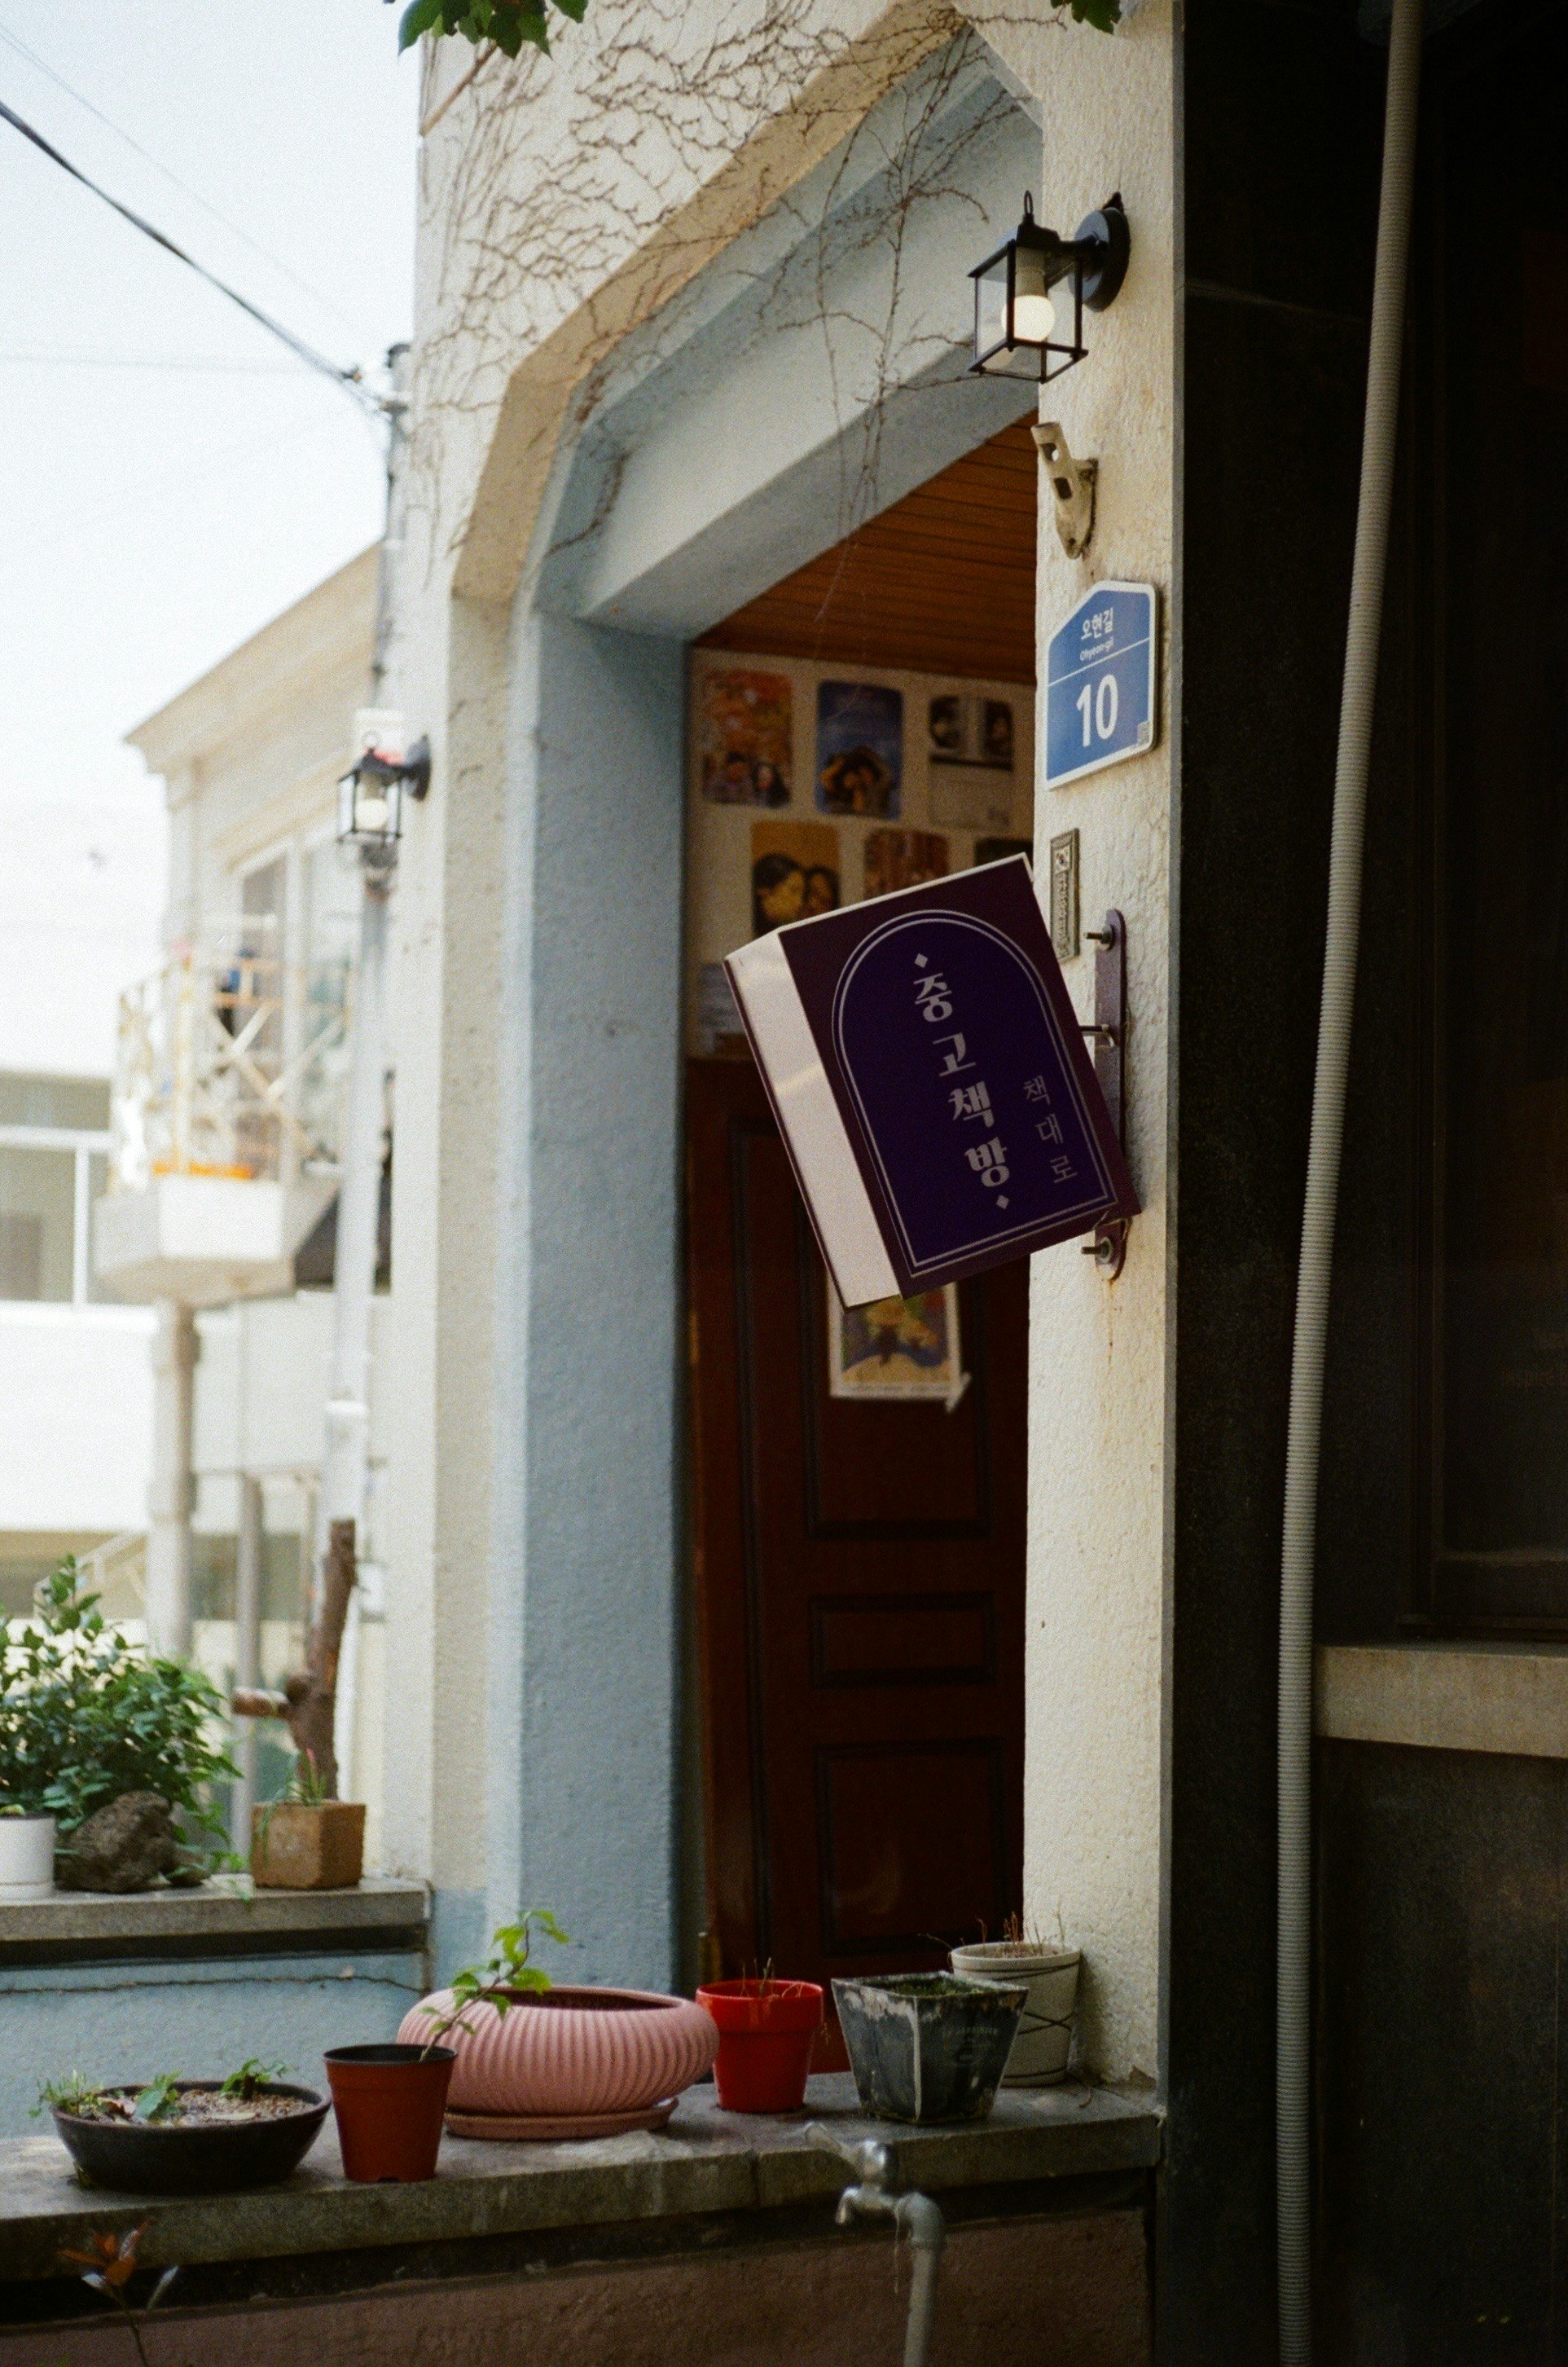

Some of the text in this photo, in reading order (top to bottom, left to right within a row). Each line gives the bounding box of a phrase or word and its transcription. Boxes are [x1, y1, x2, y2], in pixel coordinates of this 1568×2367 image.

[1080, 607, 1113, 640] 오현길
[1076, 674, 1118, 748] 10
[1023, 1075, 1078, 1184] 책대로
